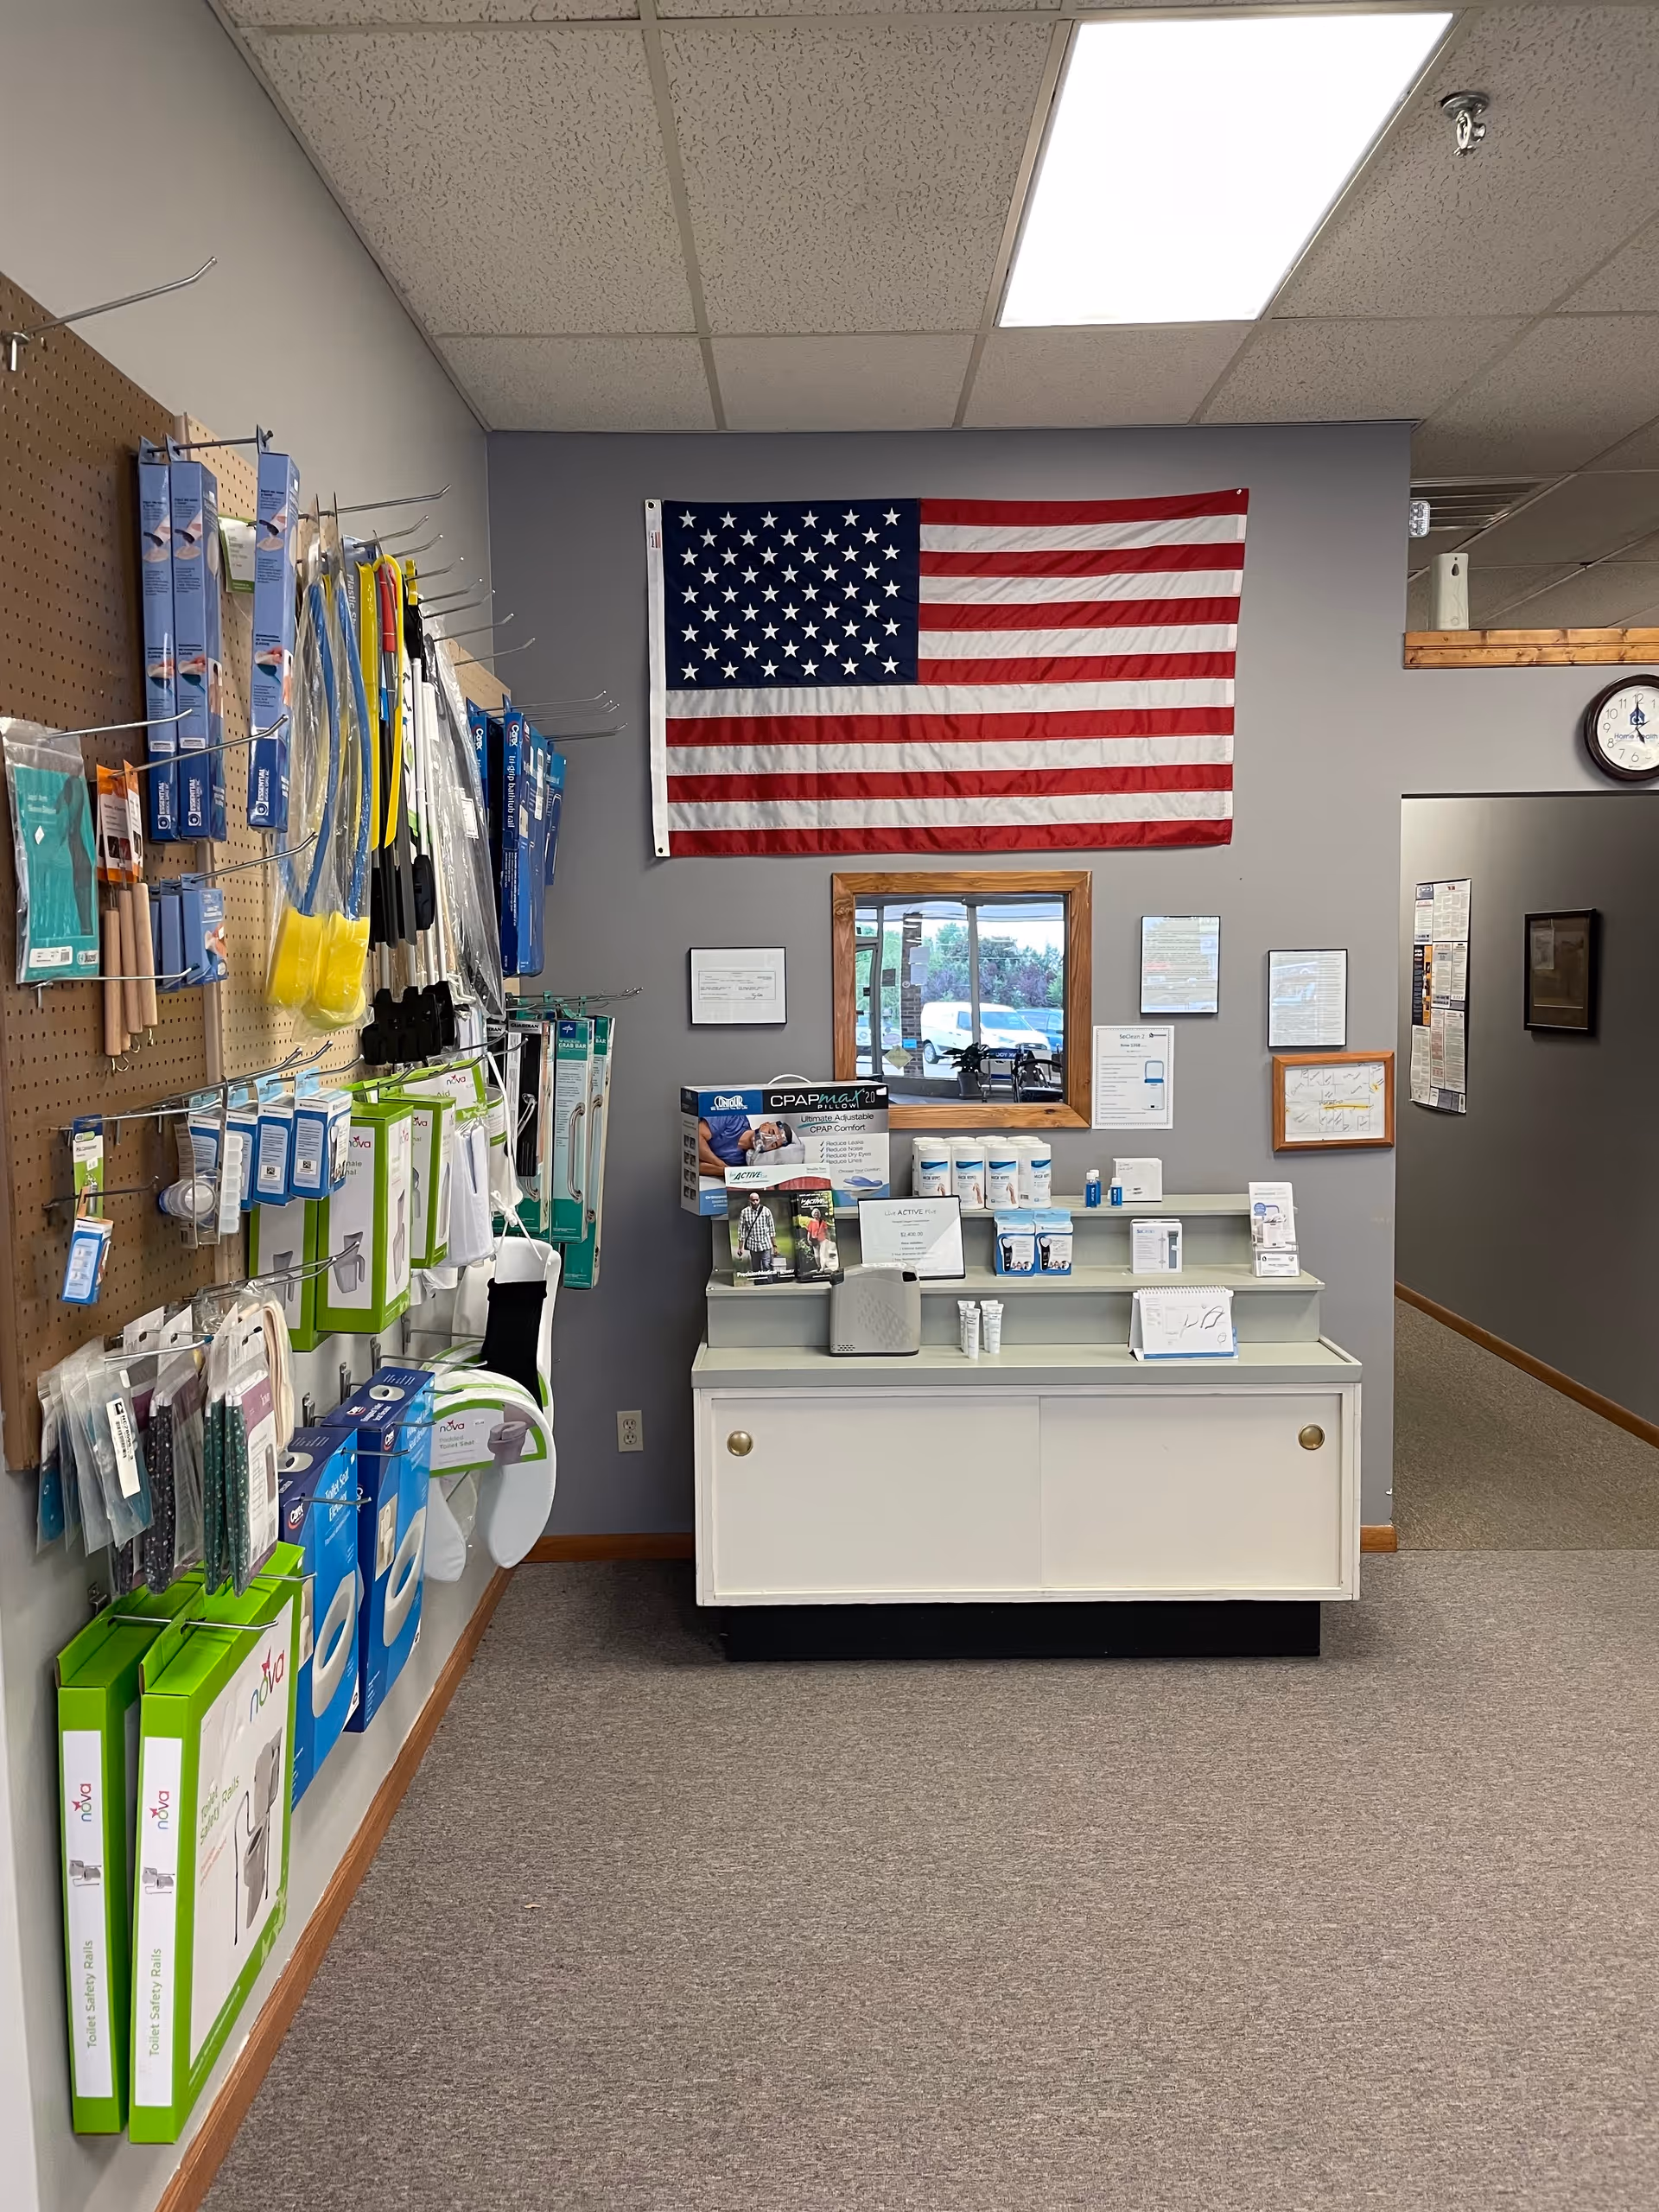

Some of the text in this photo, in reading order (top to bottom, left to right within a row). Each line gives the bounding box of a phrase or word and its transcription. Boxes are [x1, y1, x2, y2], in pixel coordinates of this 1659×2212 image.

[346, 574, 356, 609] Plastic
[1618, 698, 1627, 709] 11
[1632, 693, 1644, 704] 12
[1651, 699, 1656, 709] 1
[1605, 709, 1618, 719] 10
[1603, 722, 1611, 733] 9
[1607, 738, 1614, 748] 8
[1618, 748, 1625, 760] 7
[1631, 752, 1639, 762] 6
[446, 1076, 467, 1085] nova
[714, 1096, 744, 1107] CONTOUR
[865, 1091, 875, 1103] 2.0
[835, 1113, 874, 1122] Adjustable
[834, 1124, 866, 1133] Comfort
[439, 1422, 465, 1433] nova
[439, 1434, 464, 1443] Padded
[250, 1649, 285, 1724] nova
[222, 1775, 239, 1808] Rails
[80, 1783, 92, 1822] nova
[157, 1790, 169, 1830] nova
[84, 1940, 97, 2049] Toilet Safety Rails
[149, 1948, 162, 2057] Toilet Safety Rails
